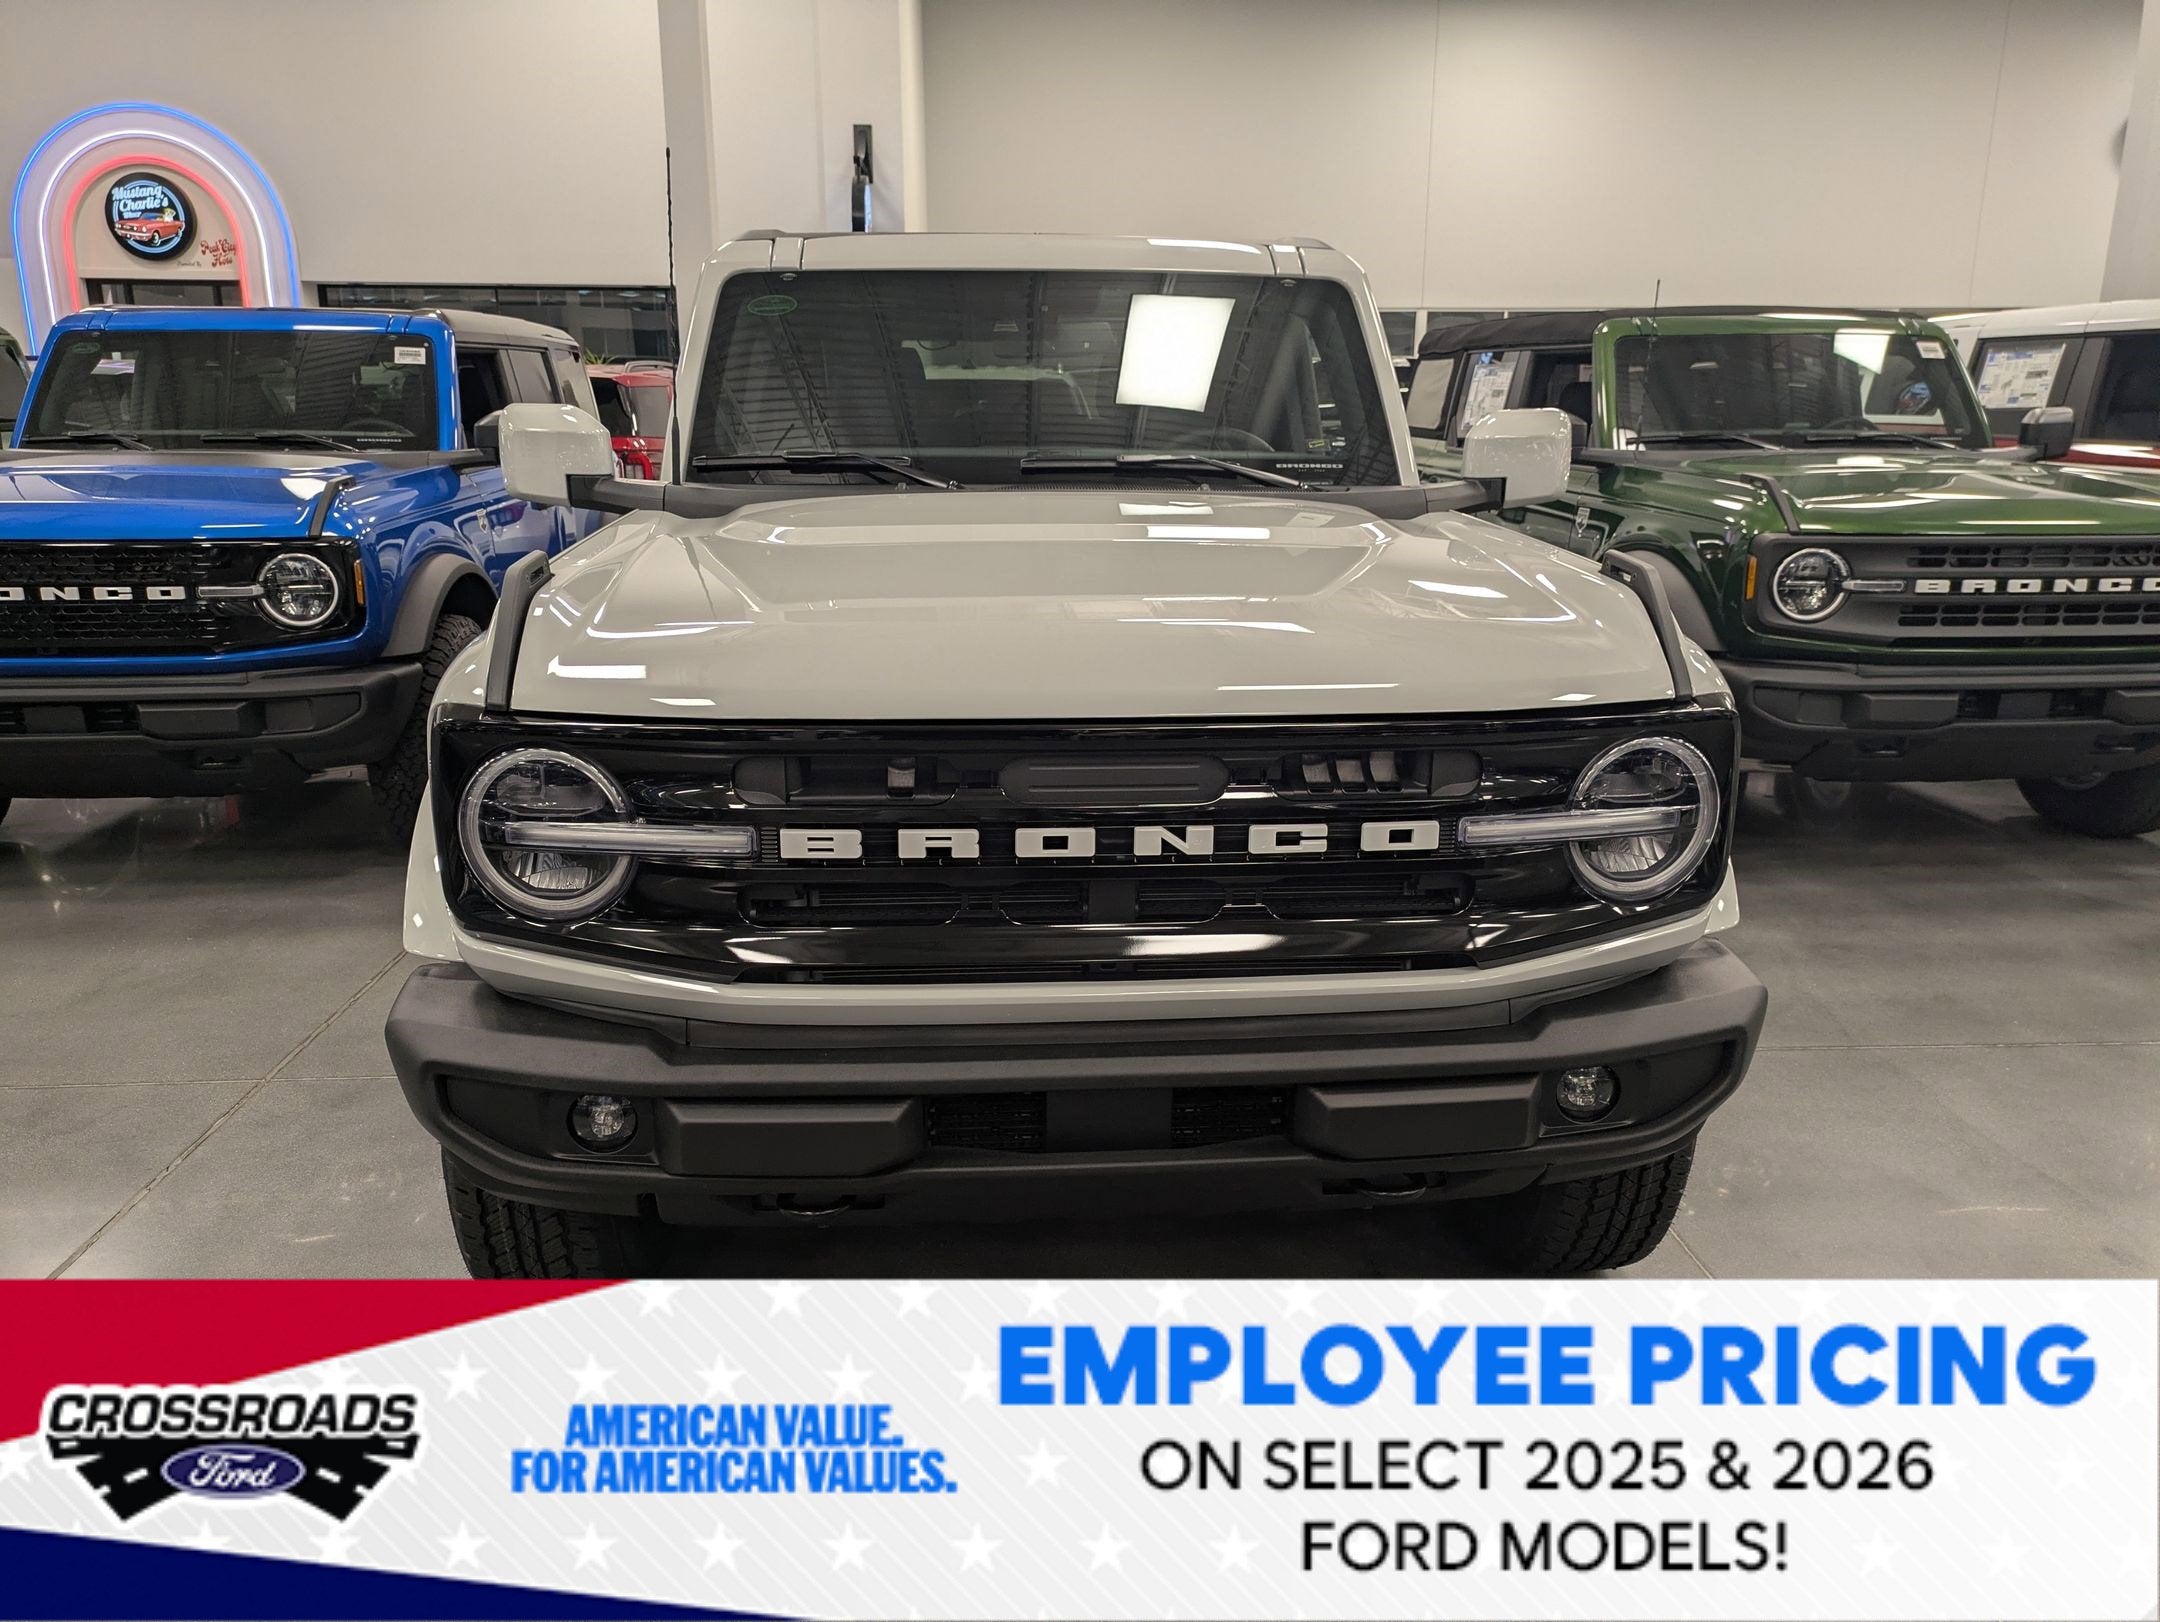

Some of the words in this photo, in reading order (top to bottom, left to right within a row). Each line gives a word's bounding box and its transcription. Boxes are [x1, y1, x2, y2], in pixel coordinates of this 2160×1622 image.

[112, 185, 163, 200] Mustang
[119, 194, 169, 212] Charlie's
[780, 821, 1440, 859] BRONCO
